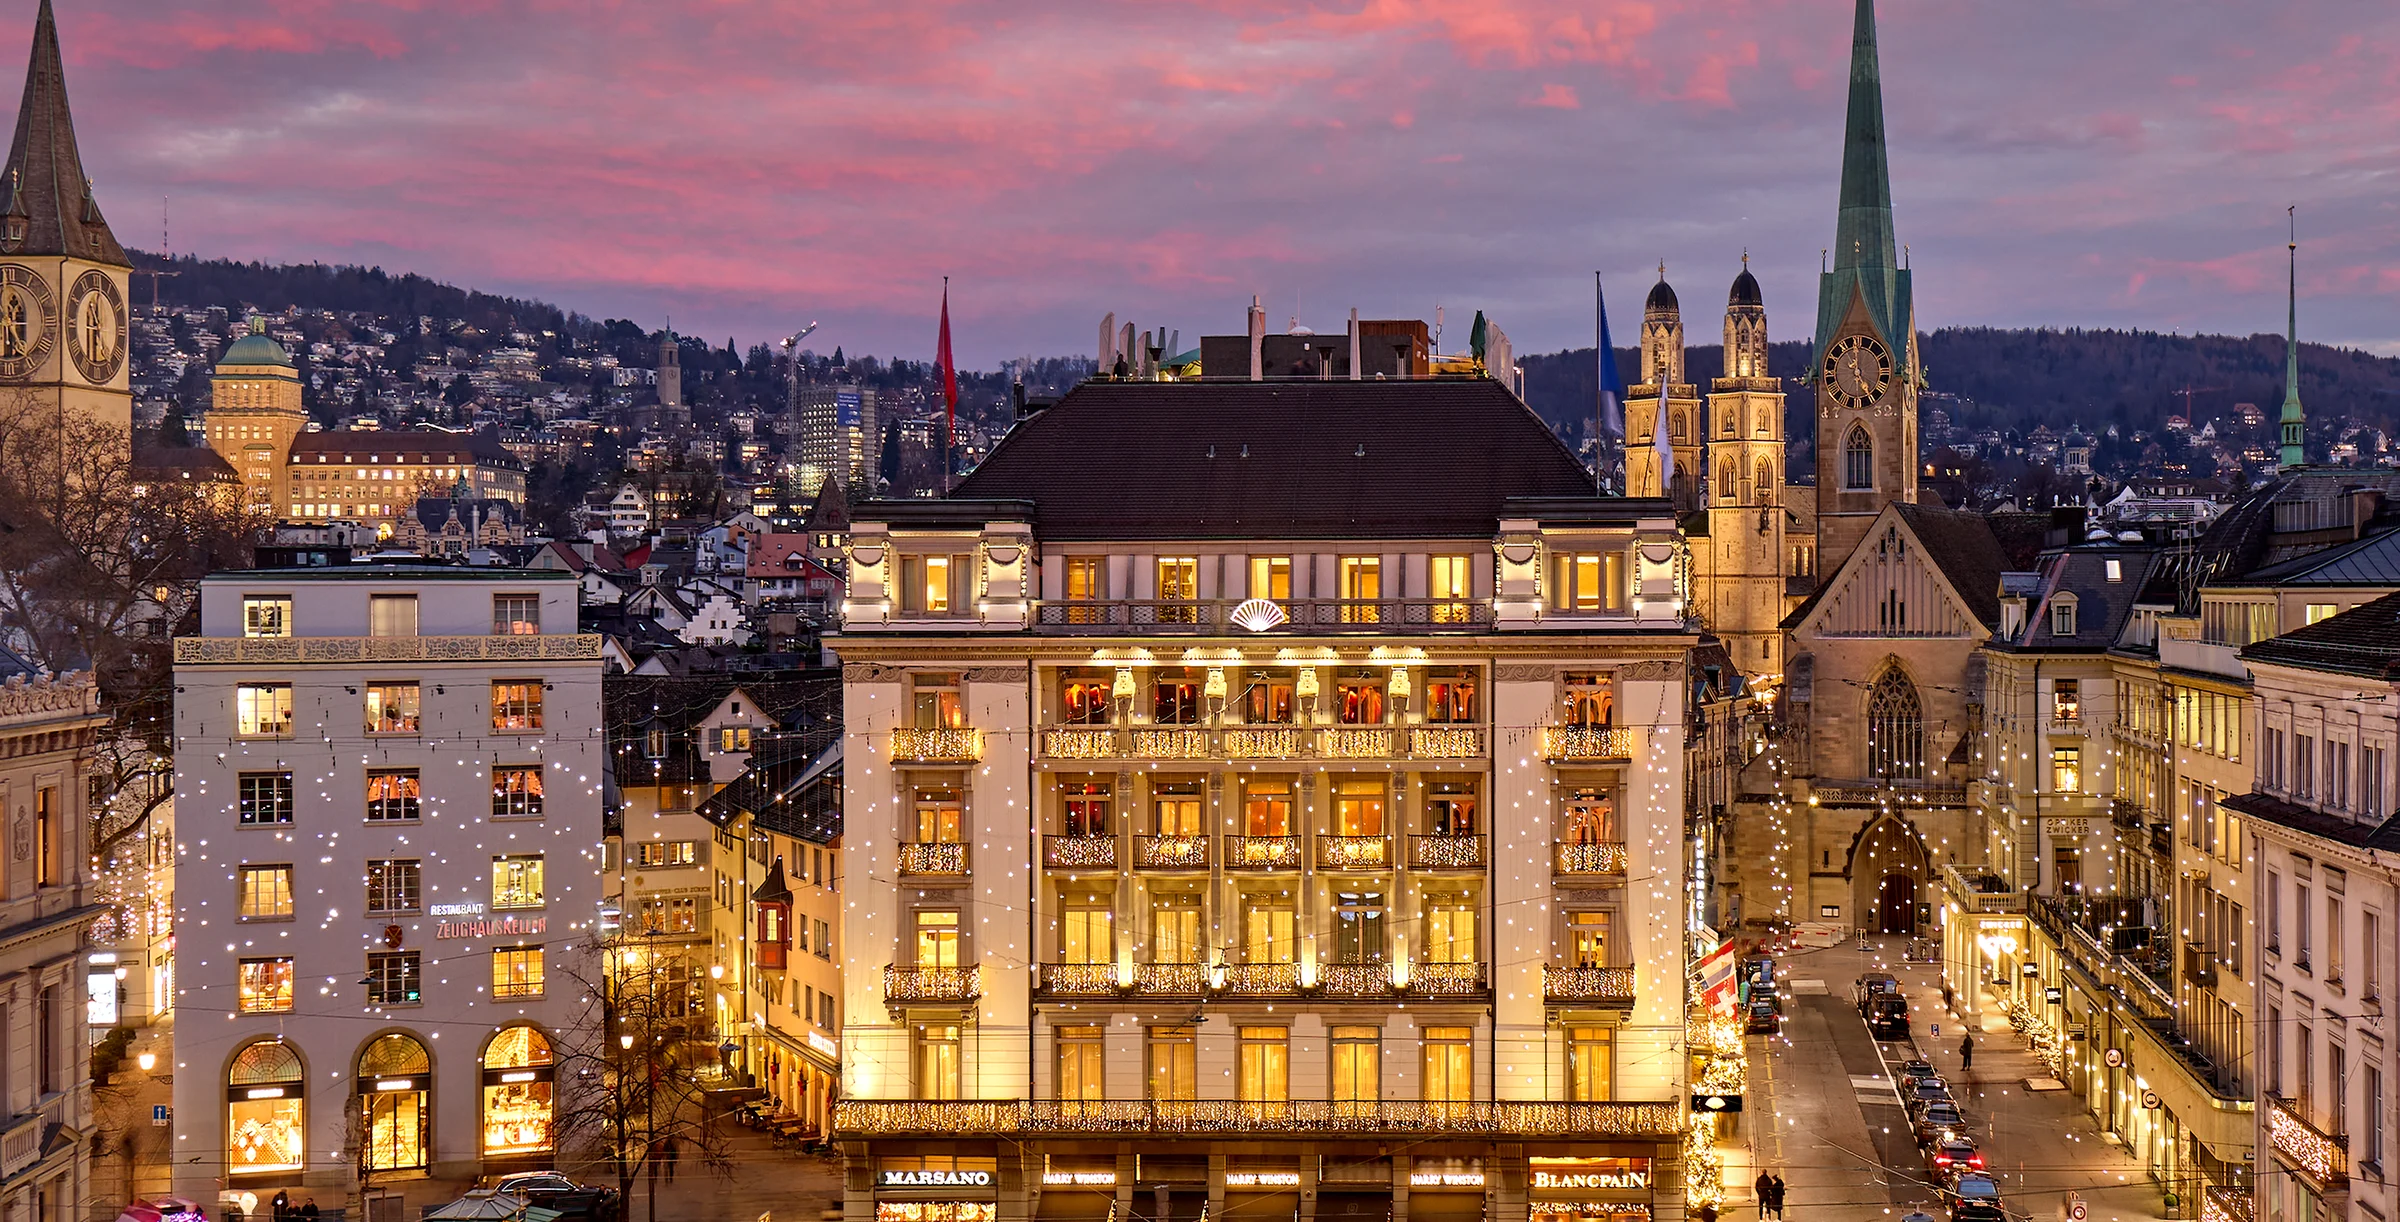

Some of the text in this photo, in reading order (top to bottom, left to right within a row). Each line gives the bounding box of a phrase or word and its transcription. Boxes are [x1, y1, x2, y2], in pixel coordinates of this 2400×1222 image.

[2046, 826, 2090, 834] ZWICKER
[430, 903, 484, 916] RESTAURANT
[436, 917, 547, 940] ZEUGHAUSKELLER
[885, 1171, 990, 1186] MARSANO
[1043, 1173, 1116, 1185] HARRY WINSTON
[1226, 1173, 1299, 1185] HARRY WINSTON
[1411, 1173, 1484, 1186] HARRY WINSTON
[1534, 1171, 1646, 1188] BLANCPAIN
